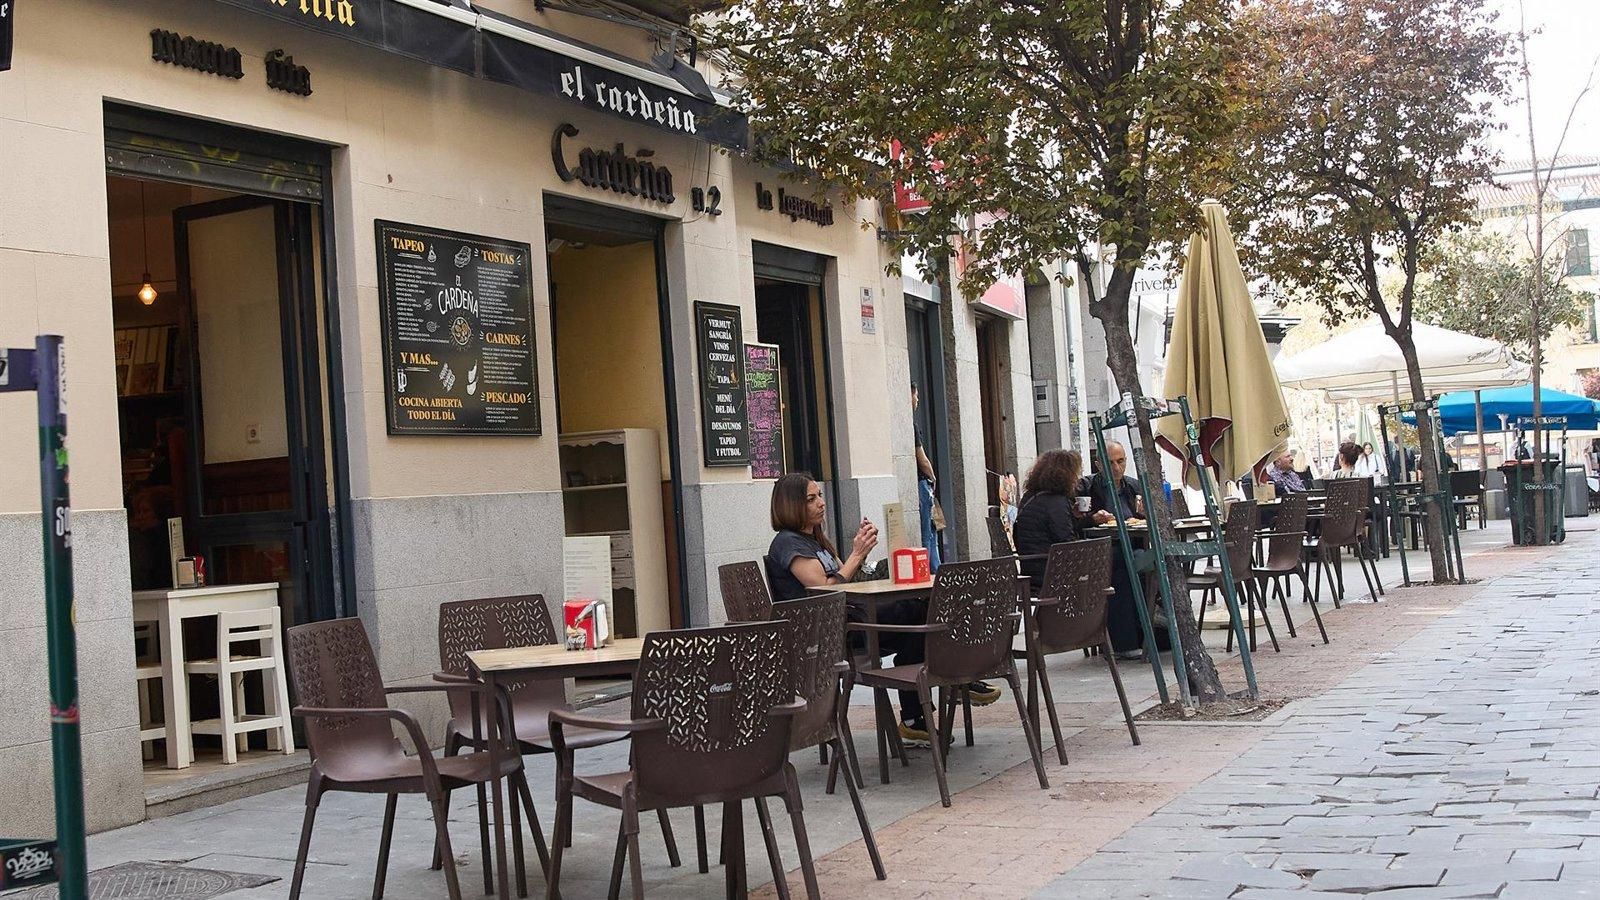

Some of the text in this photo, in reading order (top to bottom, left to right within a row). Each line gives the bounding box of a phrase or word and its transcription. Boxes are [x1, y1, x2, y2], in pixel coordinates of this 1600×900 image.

[560, 66, 698, 135] el cardeña
[551, 123, 676, 204] Cardeña
[391, 236, 425, 253] TAPEO
[481, 249, 515, 265] TOSTAS
[455, 274, 462, 287] EL
[438, 287, 480, 319] CARDEÑA
[708, 319, 731, 329] VERMUT
[486, 332, 521, 345] CARNES
[708, 330, 732, 340] SANGRÍA
[713, 342, 730, 351] VINOS
[400, 352, 409, 364] Y
[708, 352, 736, 363] CERVEZAS
[398, 397, 463, 408] COCINA ABIERTA
[486, 391, 526, 404] PESCADO
[717, 392, 733, 403] MENÚ
[715, 404, 736, 414] DEL DÍA
[407, 409, 456, 421] TODO EL DÍA
[711, 421, 742, 430] DESAYUNOS
[719, 437, 737, 445] TAPEO
[715, 448, 742, 457] Y FUTBOL
